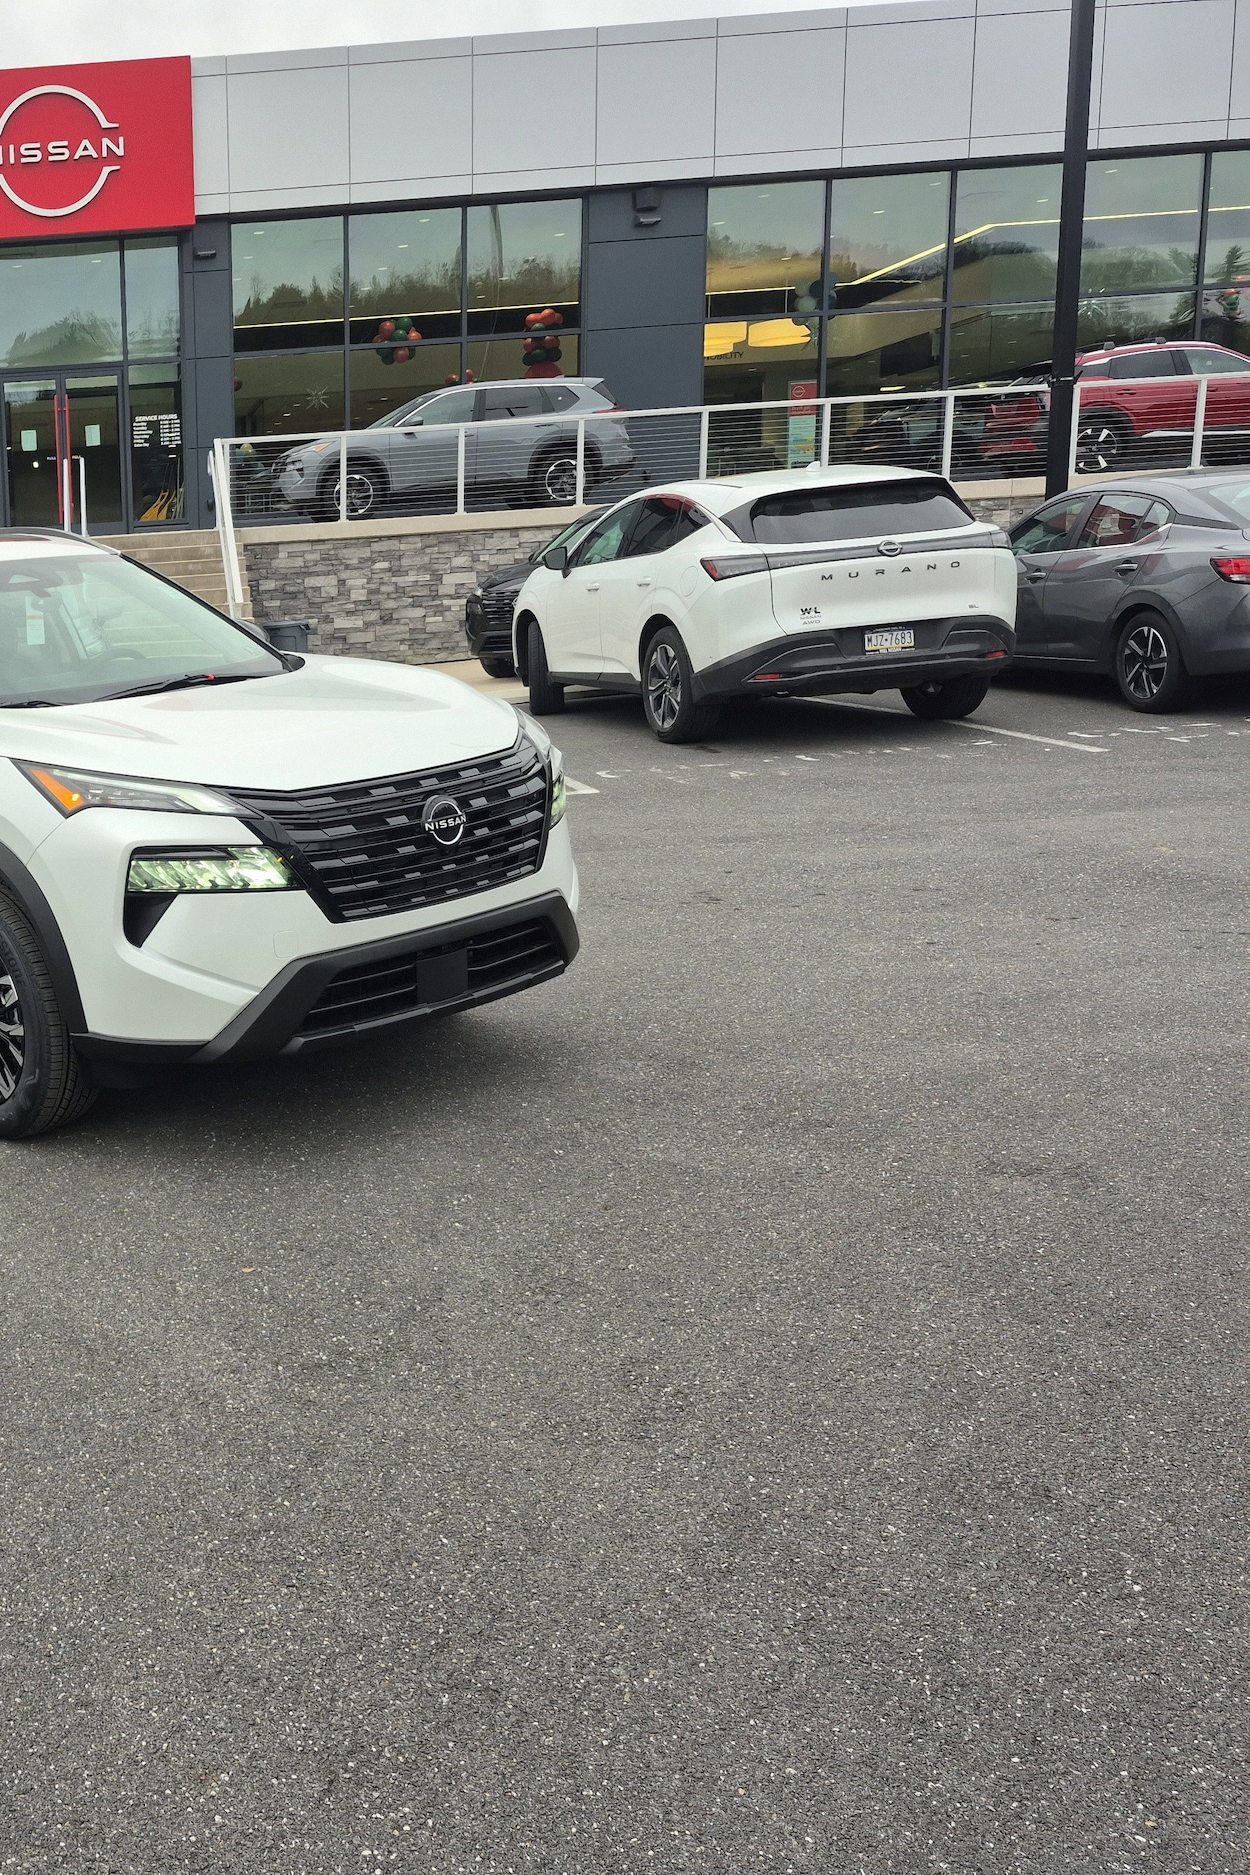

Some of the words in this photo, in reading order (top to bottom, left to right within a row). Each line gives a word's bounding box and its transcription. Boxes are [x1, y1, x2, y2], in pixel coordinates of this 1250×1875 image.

[158, 413, 178, 421] HOURS
[821, 561, 960, 581] MURANO
[424, 814, 467, 832] NISSAN
